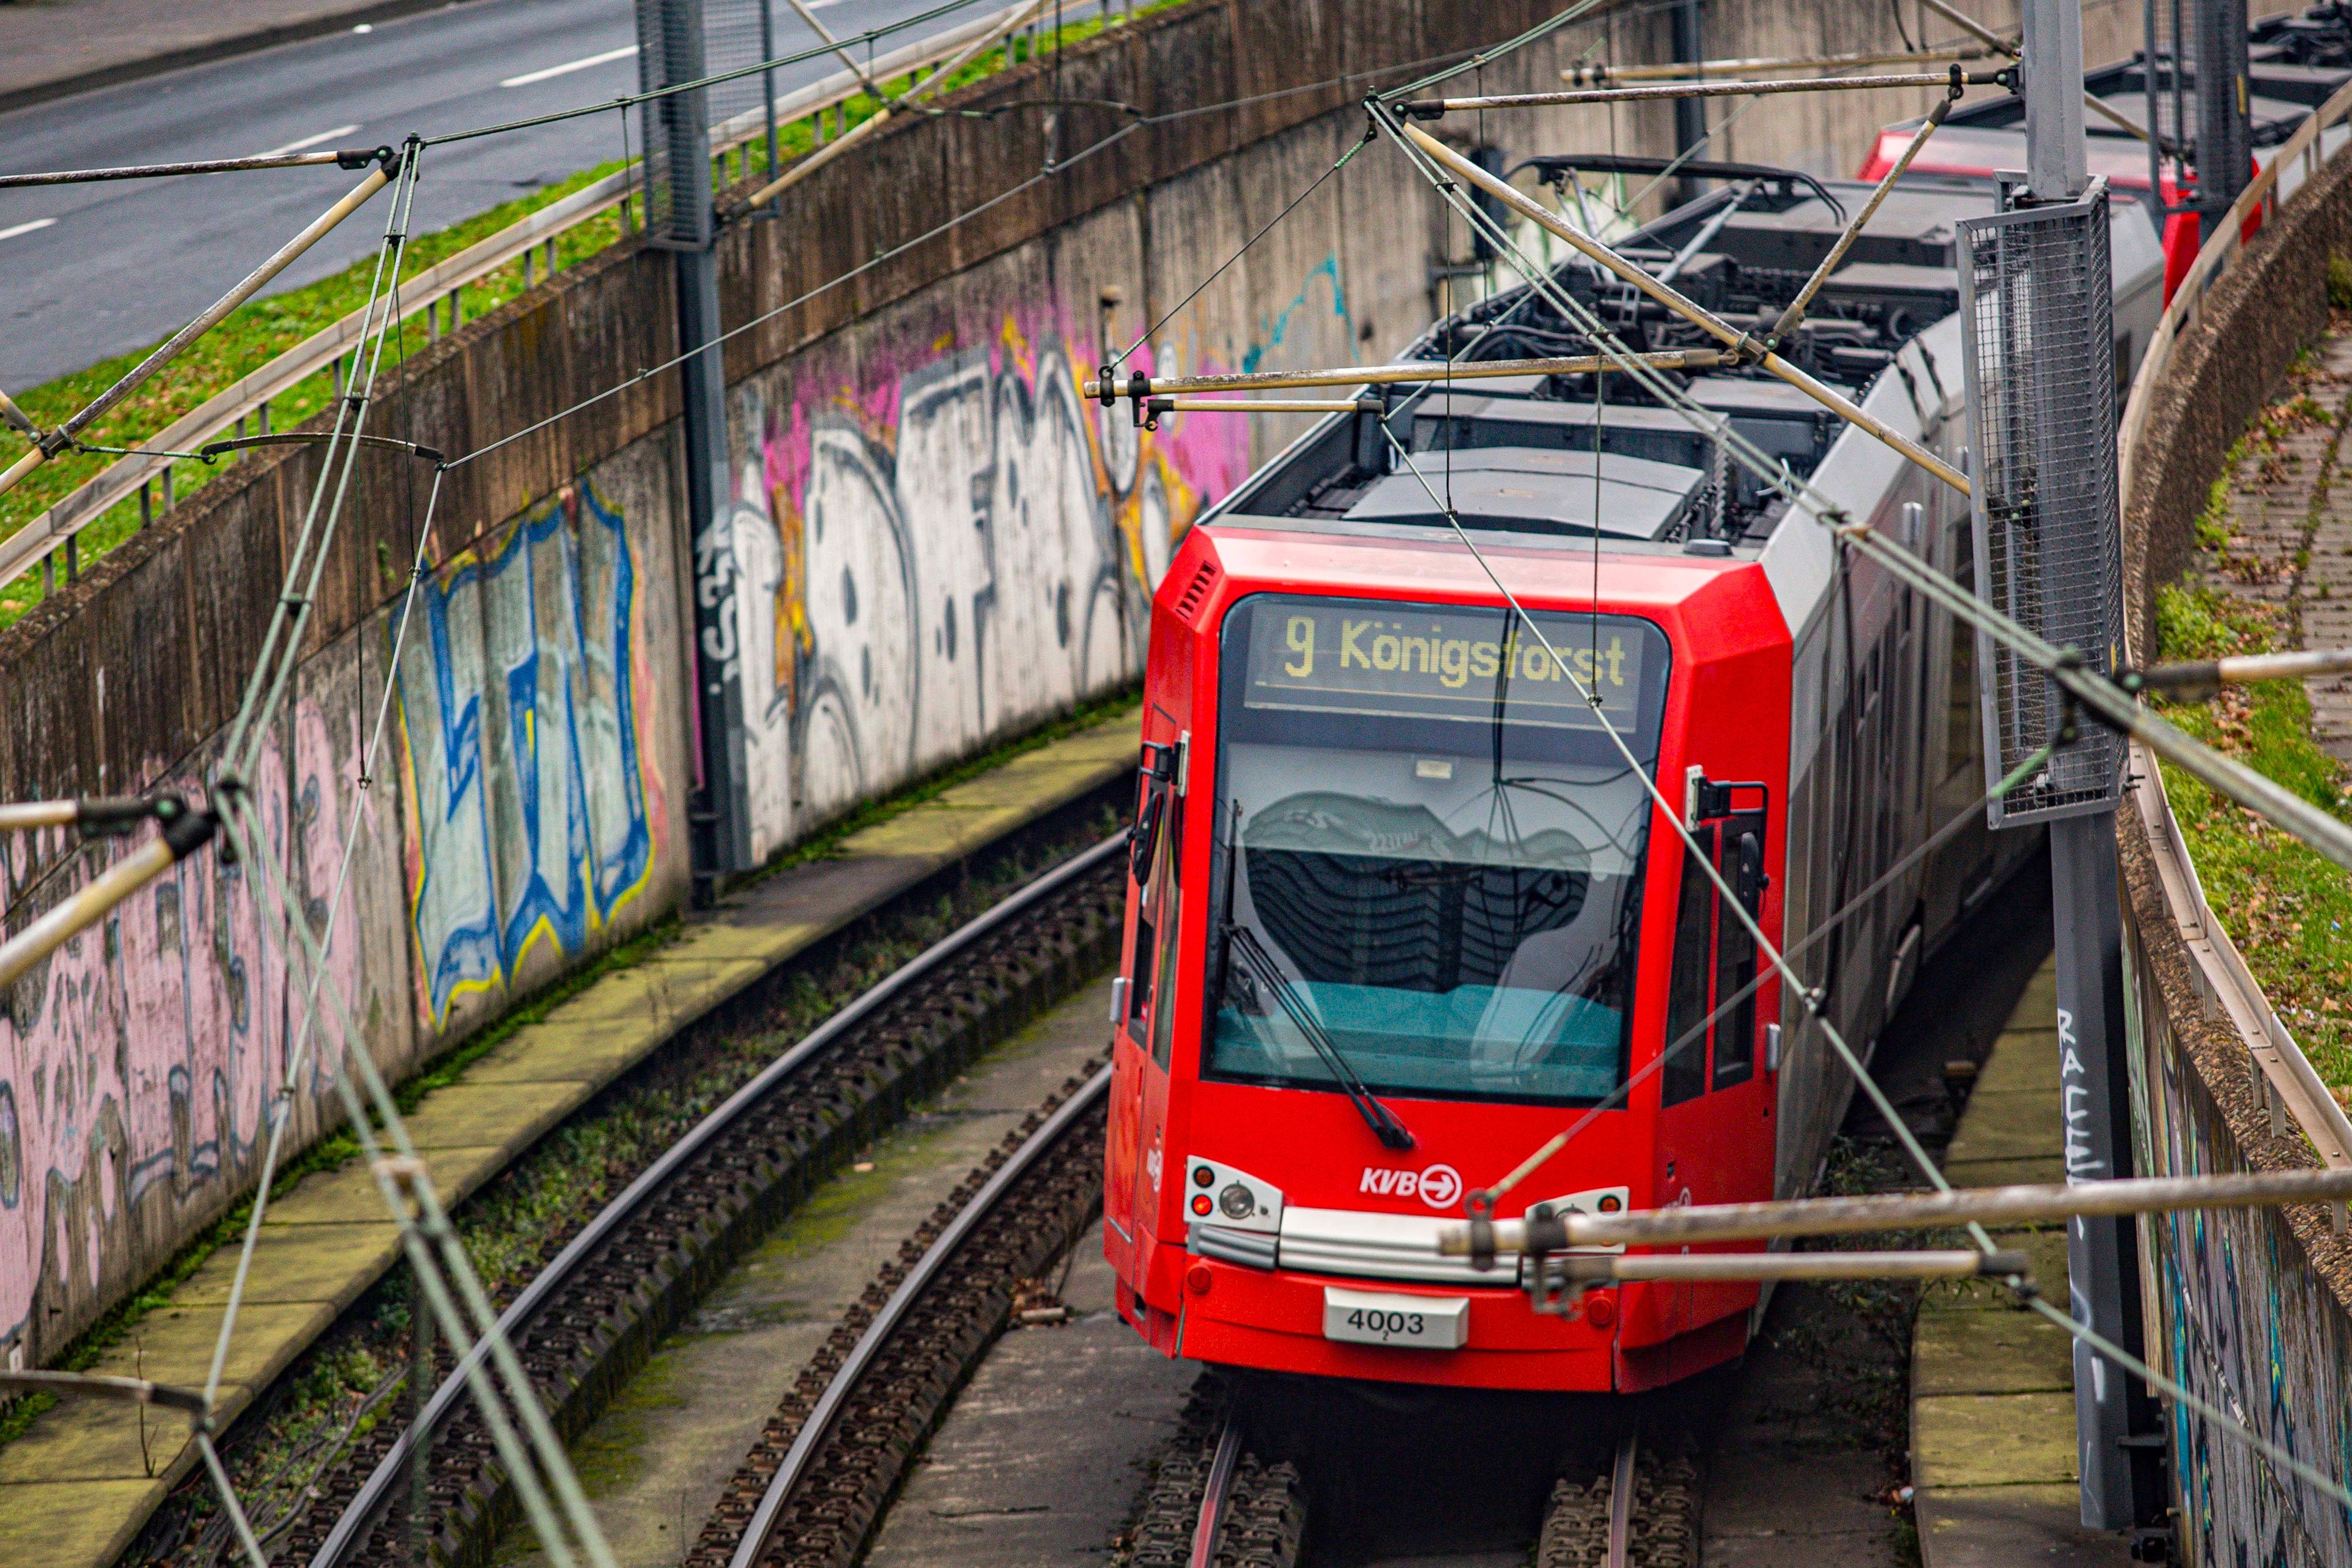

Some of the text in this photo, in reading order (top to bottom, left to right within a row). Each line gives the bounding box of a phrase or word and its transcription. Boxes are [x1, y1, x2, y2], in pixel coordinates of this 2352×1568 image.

[1285, 617, 1625, 687] 9 Königsforst
[1359, 1166, 1419, 1196] KVB
[1347, 1309, 1424, 1335] 4003
